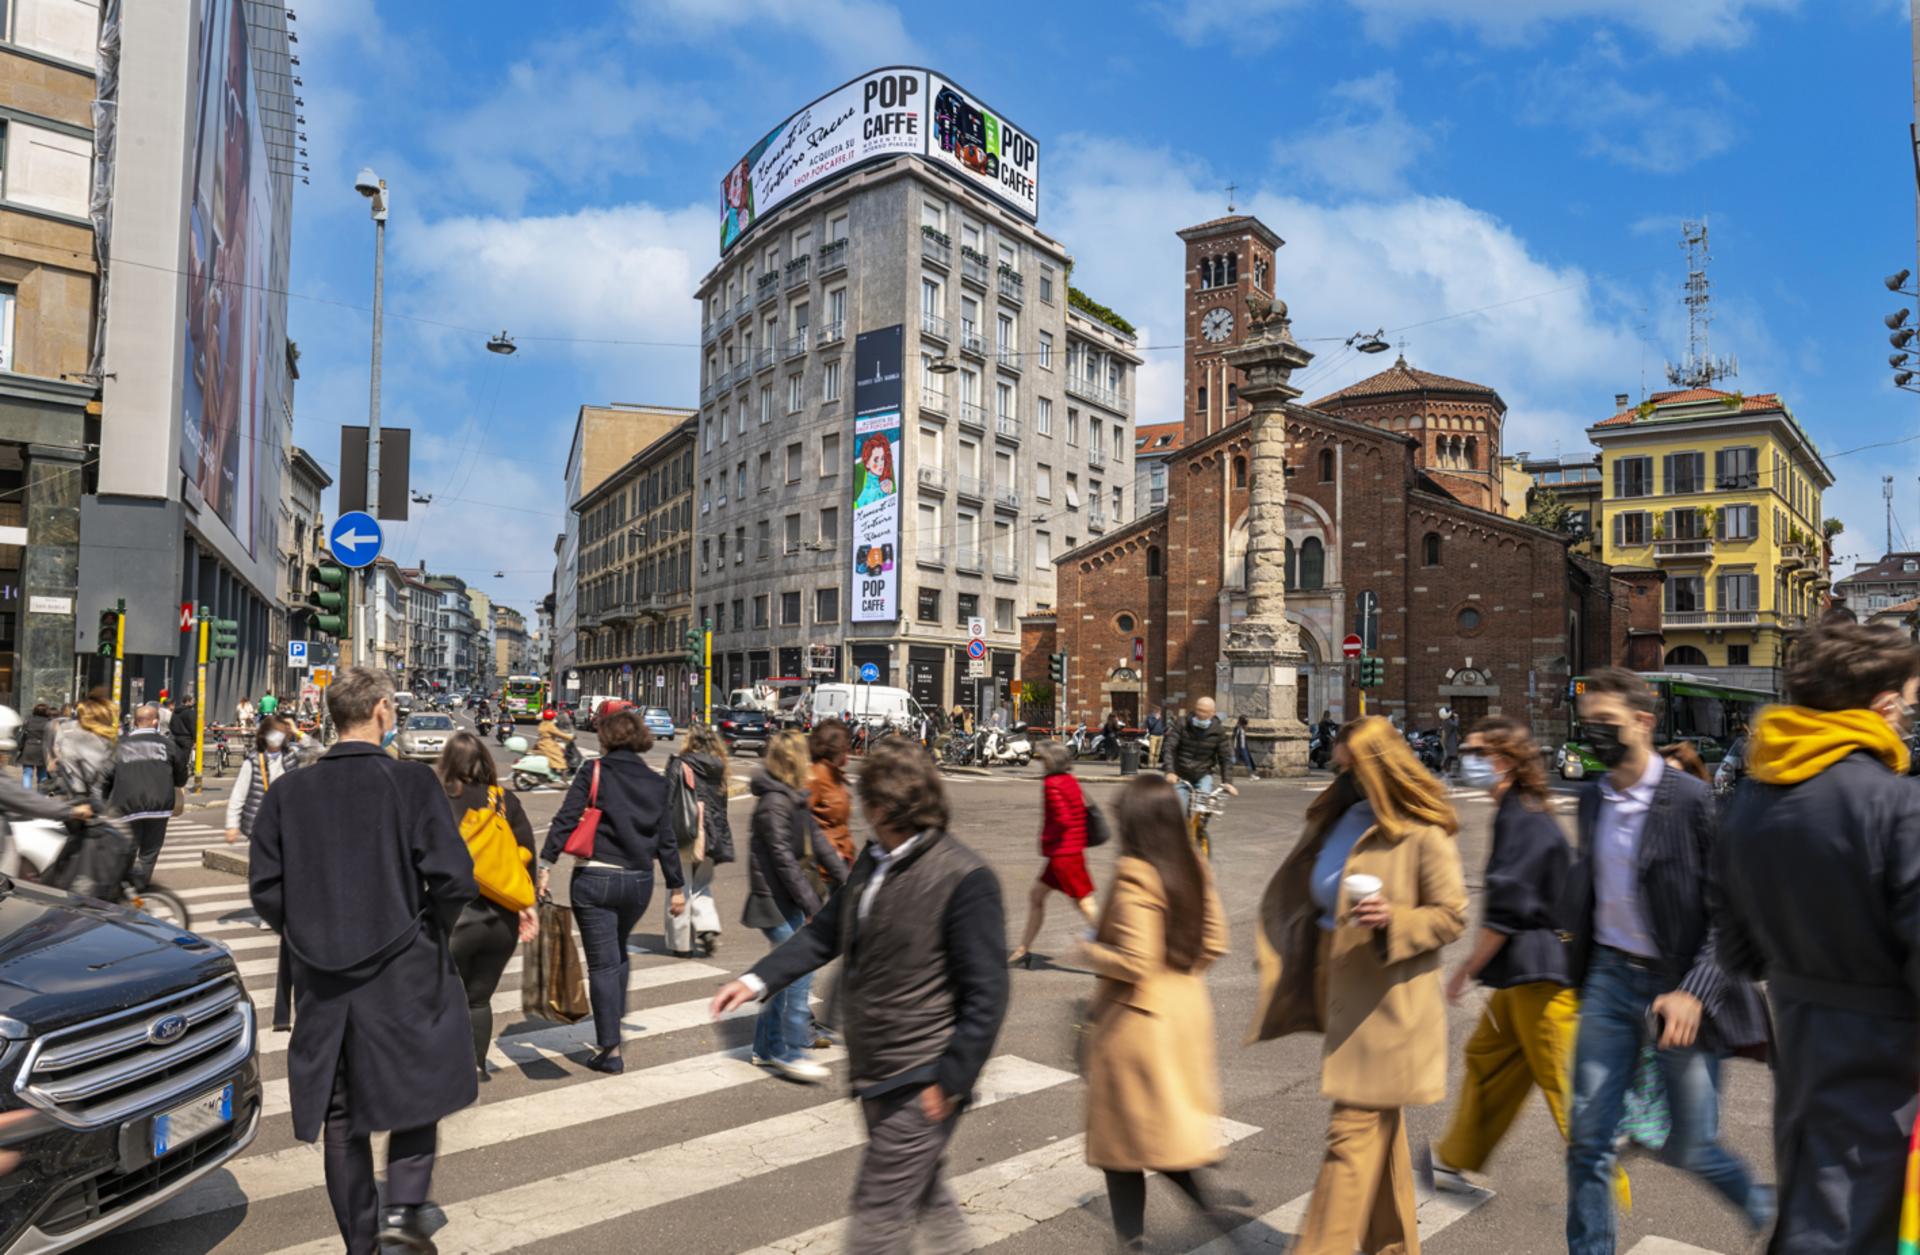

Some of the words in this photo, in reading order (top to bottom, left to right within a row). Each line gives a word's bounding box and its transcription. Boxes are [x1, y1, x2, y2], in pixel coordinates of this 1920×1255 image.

[864, 75, 918, 114] POP
[809, 143, 843, 166] ACQUISTA
[845, 138, 855, 149] SU
[1002, 124, 1035, 172] POP
[862, 579, 885, 597] POP
[293, 643, 303, 655] P
[161, 1020, 183, 1037] Ford
